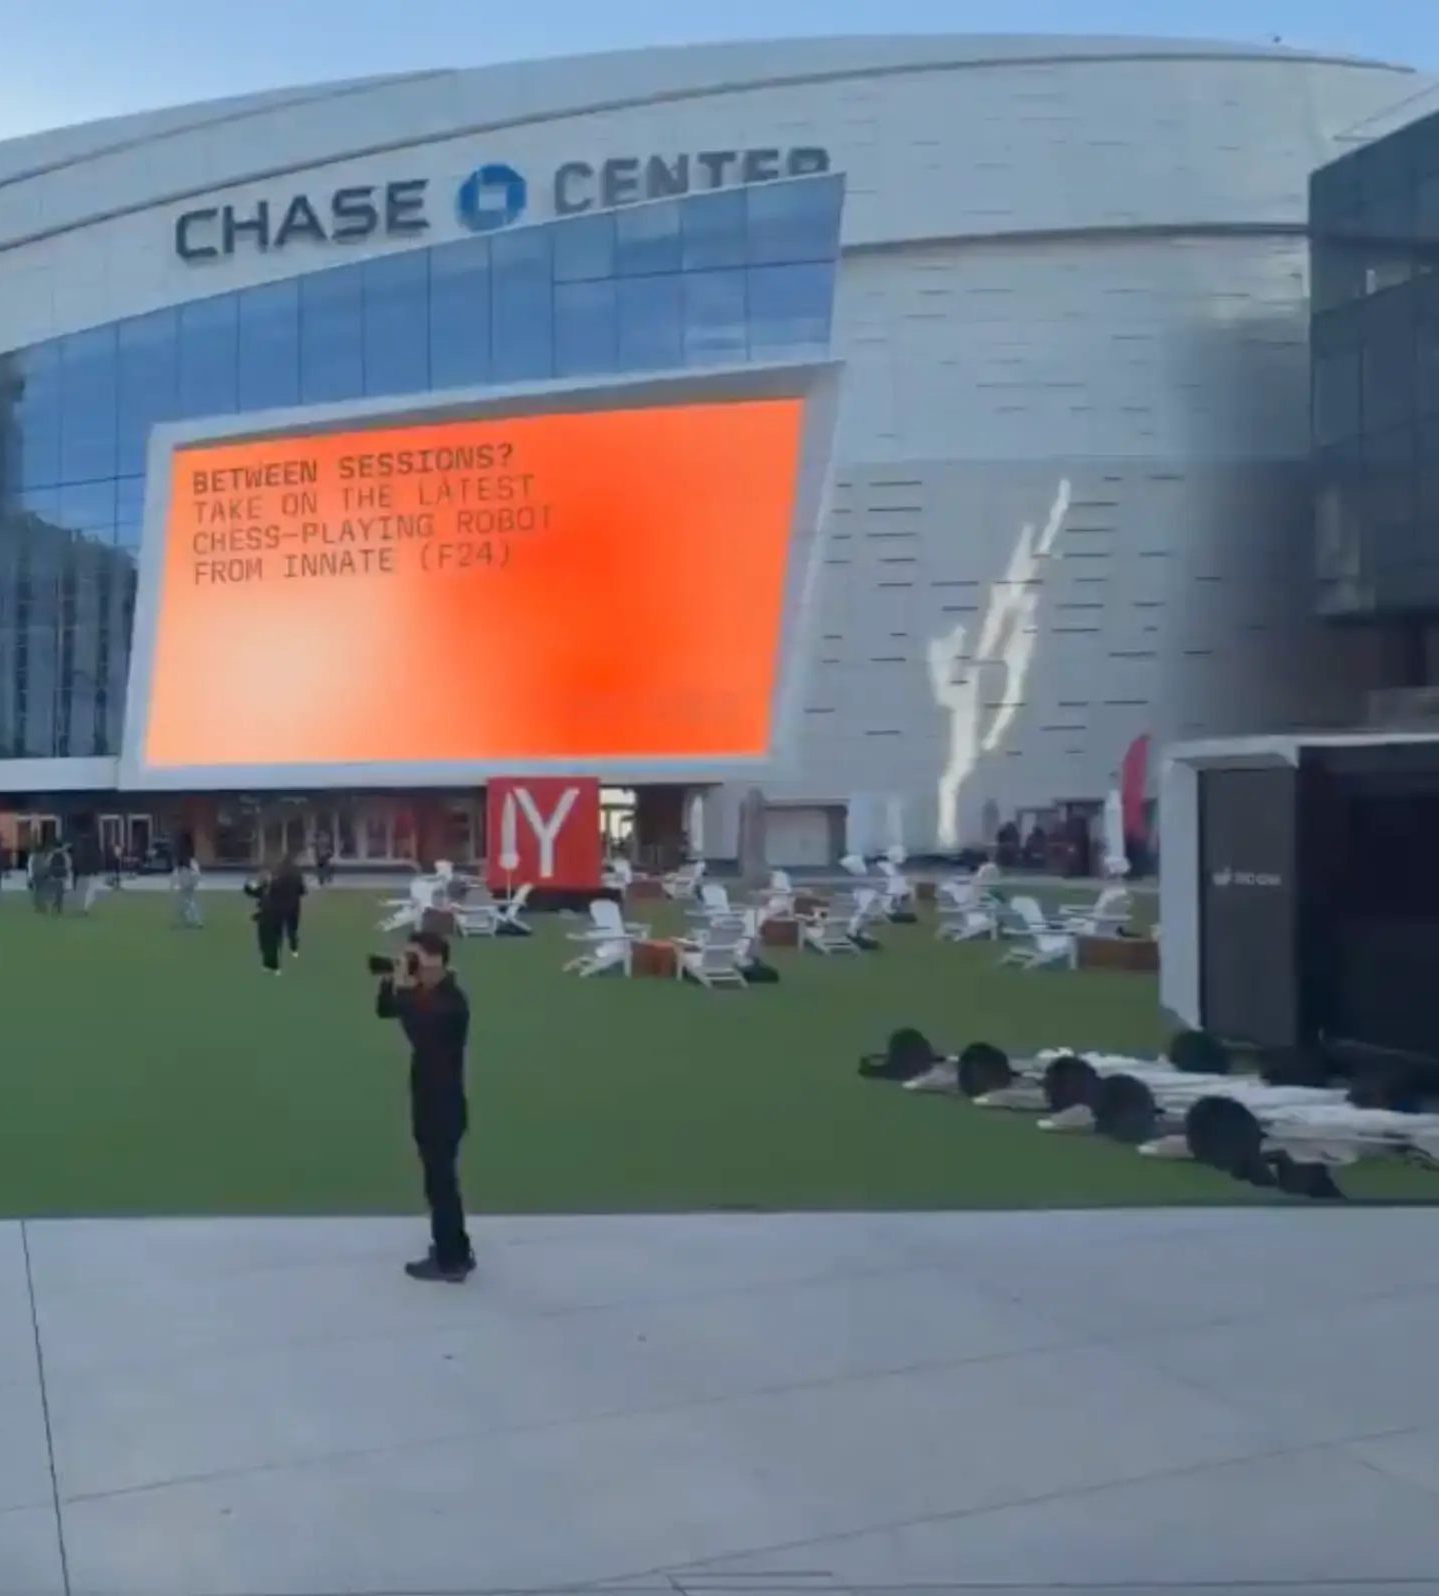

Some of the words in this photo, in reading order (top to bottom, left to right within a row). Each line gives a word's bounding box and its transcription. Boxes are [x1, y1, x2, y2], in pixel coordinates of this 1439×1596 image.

[175, 178, 431, 261] CHASE
[192, 459, 318, 495] BETWEEN
[338, 442, 514, 481] SESSIONS?
[195, 495, 263, 524] TAKE
[280, 492, 318, 518] ON
[341, 484, 393, 511] THE
[418, 473, 535, 507] LATEST
[192, 512, 435, 556] CHESS-PLAYING
[457, 505, 553, 535] ROBOT
[194, 557, 263, 585] FROM
[283, 546, 394, 579] INNATE
[420, 541, 513, 573] (F24)
